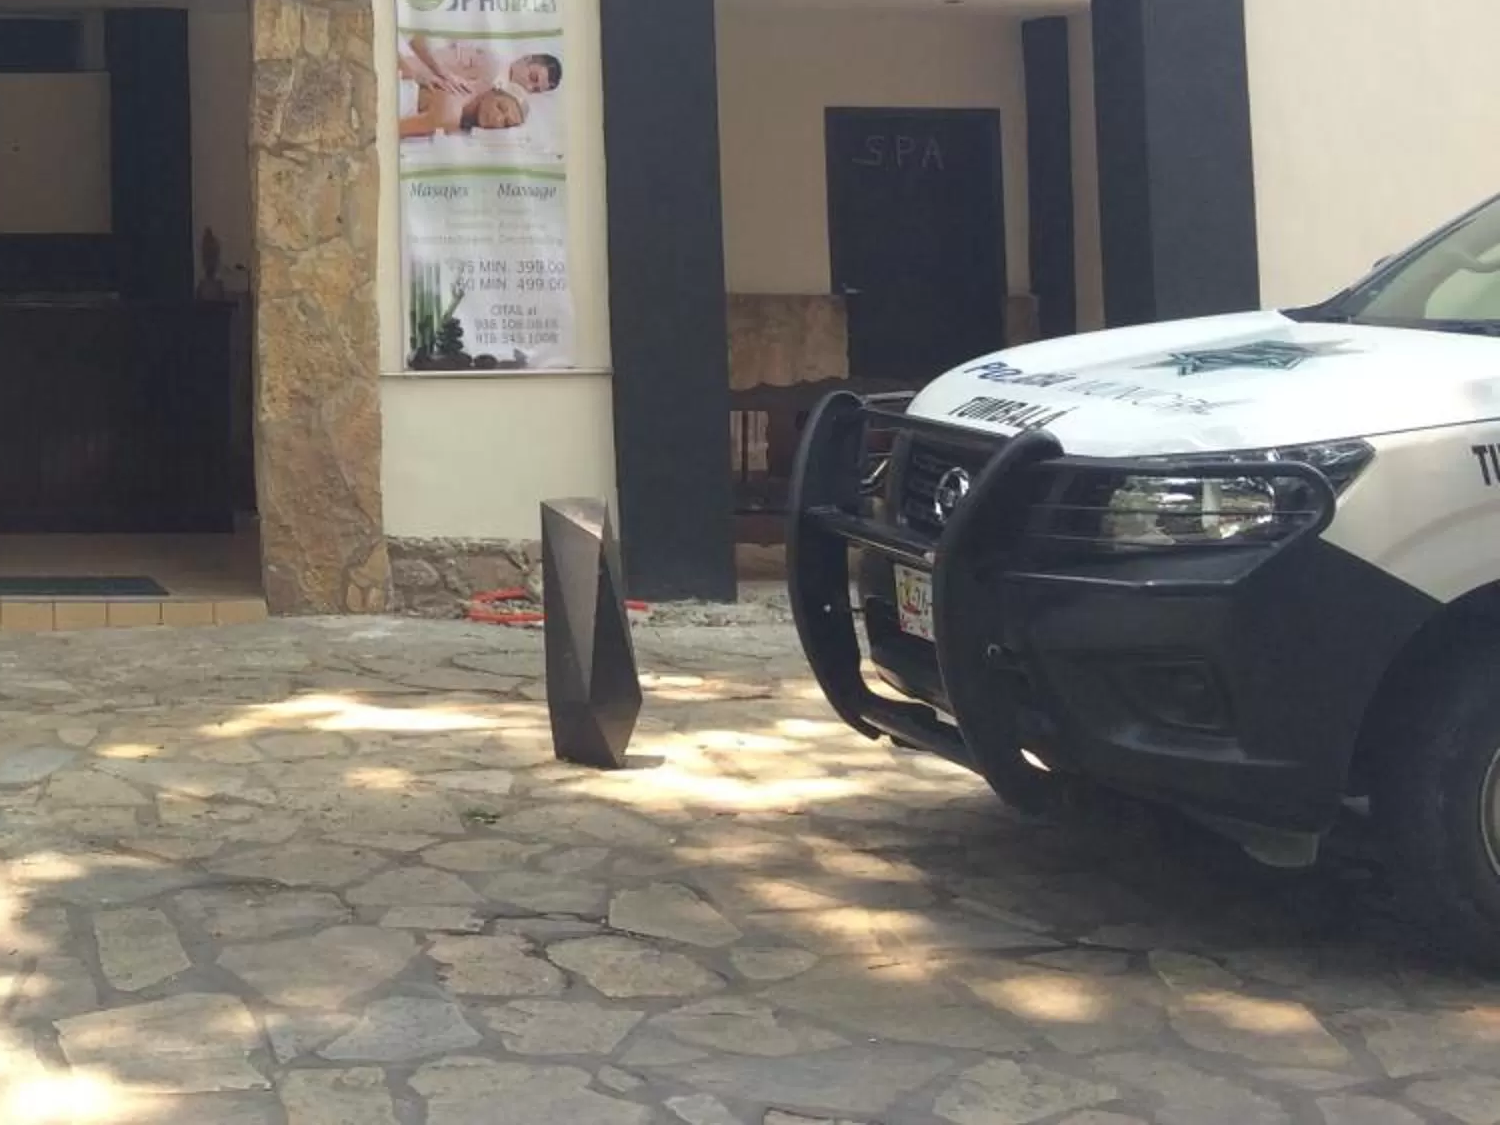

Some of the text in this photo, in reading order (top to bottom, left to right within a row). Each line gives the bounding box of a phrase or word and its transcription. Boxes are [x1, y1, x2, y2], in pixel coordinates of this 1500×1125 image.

[852, 134, 944, 172] SPA
[408, 182, 557, 200] Masajes Massage
